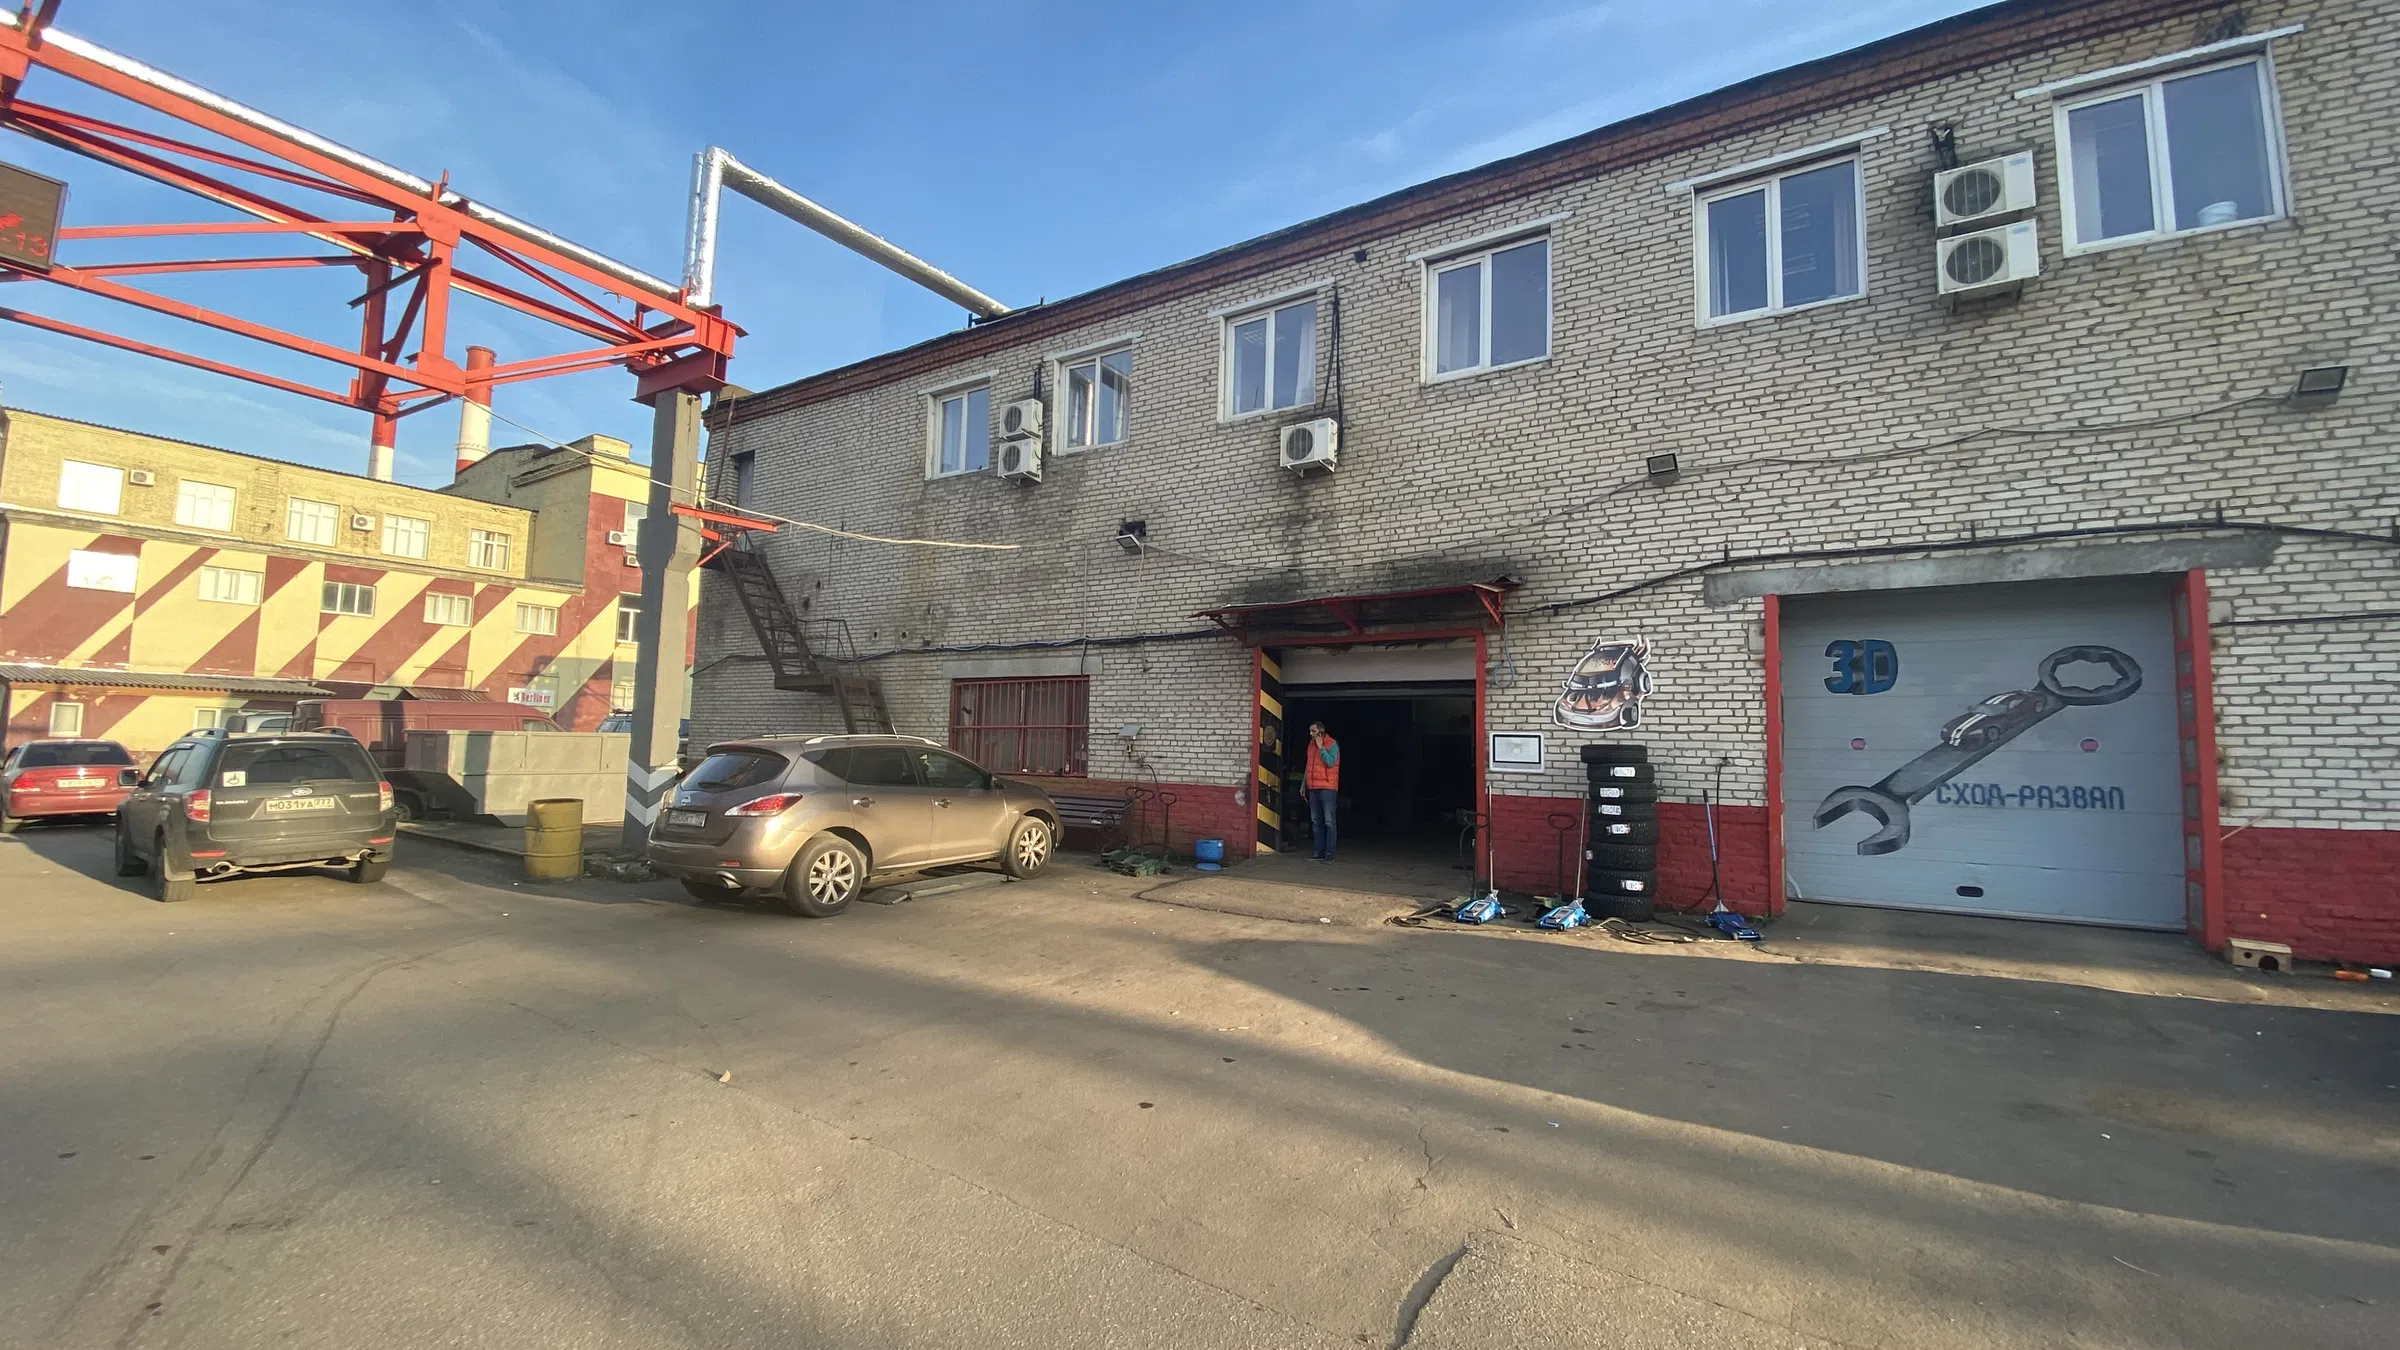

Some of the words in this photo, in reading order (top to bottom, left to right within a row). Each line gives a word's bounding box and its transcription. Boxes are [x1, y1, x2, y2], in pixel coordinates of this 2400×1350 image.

[1824, 639, 1898, 695] 3D
[520, 691, 551, 703] Berliner
[1936, 783, 2125, 810] СХОД-РАЗВАЛ
